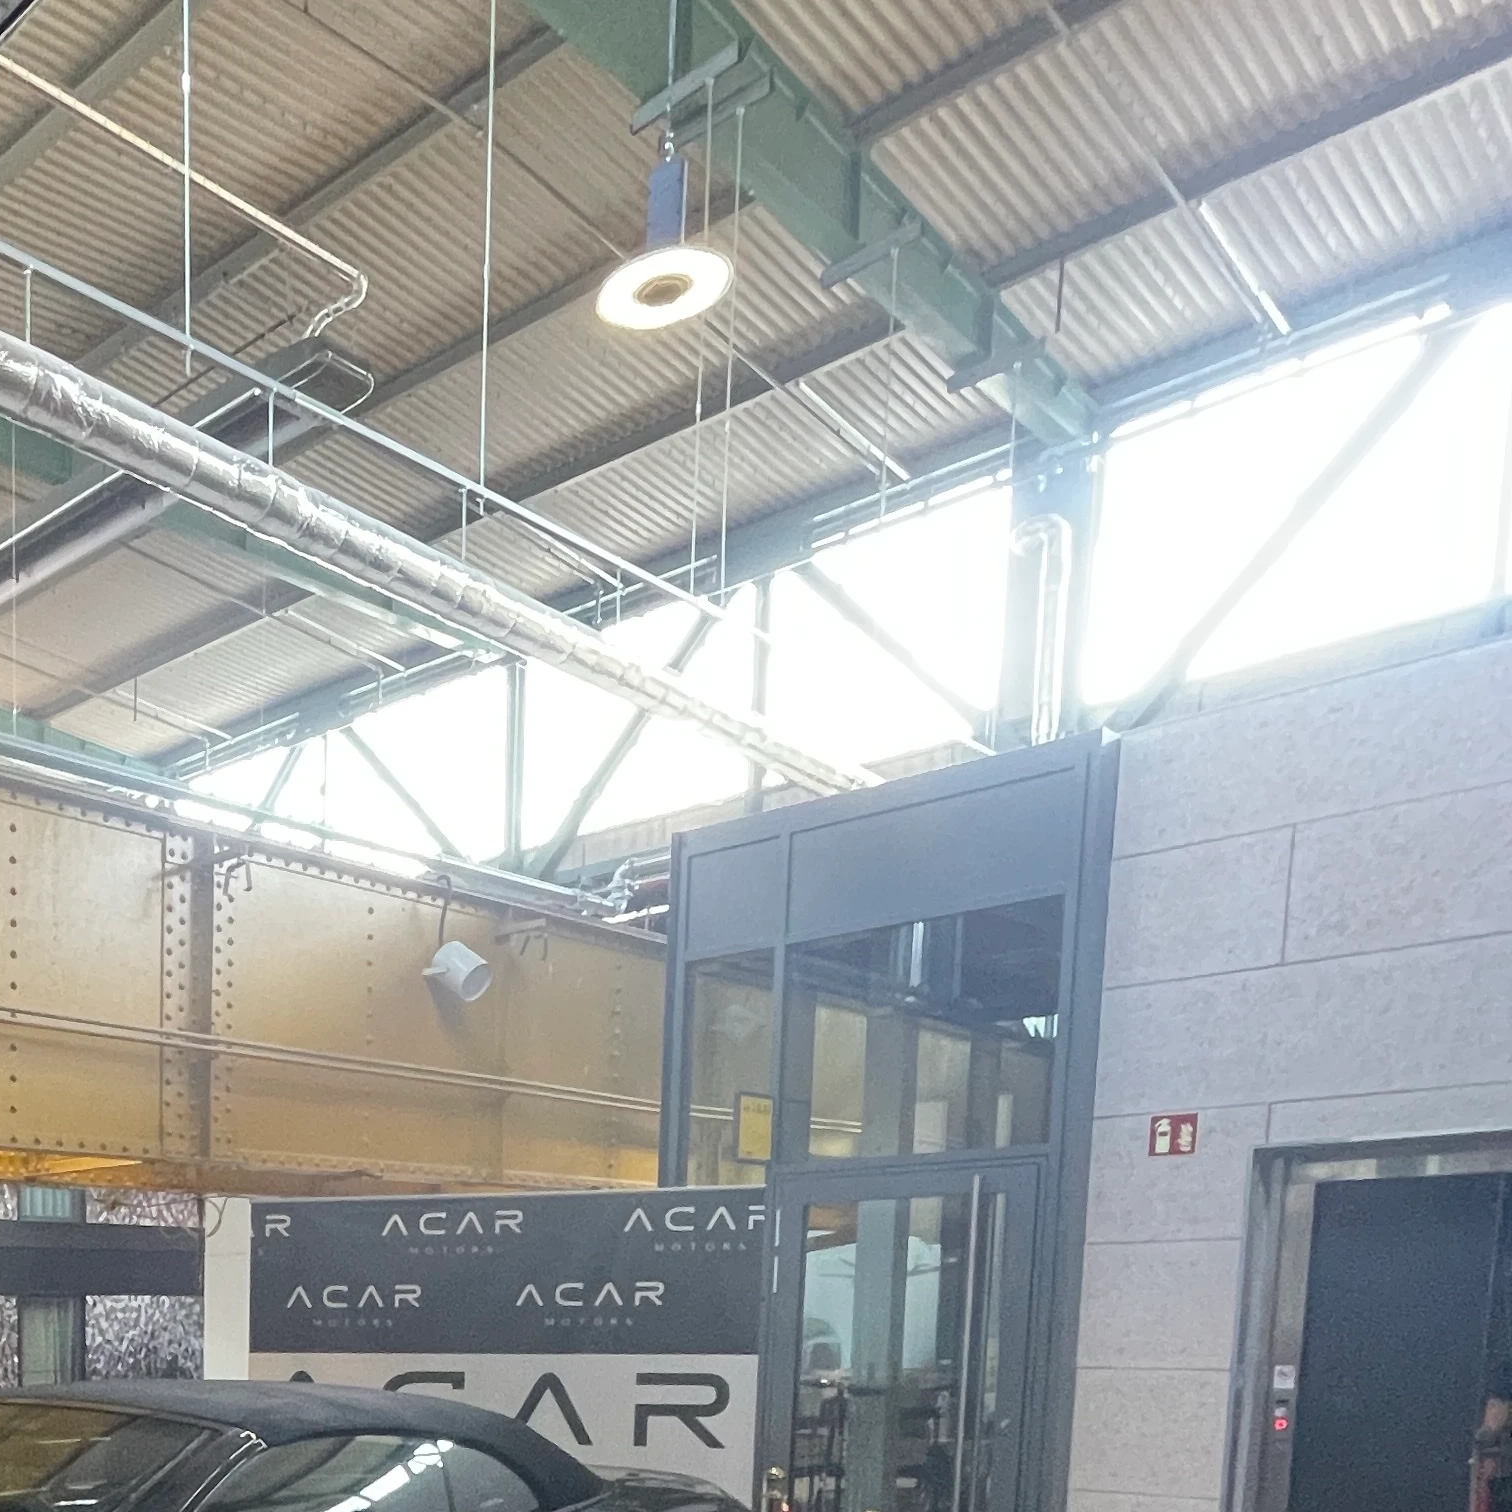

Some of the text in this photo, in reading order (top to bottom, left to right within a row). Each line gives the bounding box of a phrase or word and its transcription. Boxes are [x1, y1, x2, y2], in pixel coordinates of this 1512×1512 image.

[381, 1209, 524, 1237] ACAR
[287, 1284, 422, 1308] ACAR
[515, 1281, 665, 1307] ACAR
